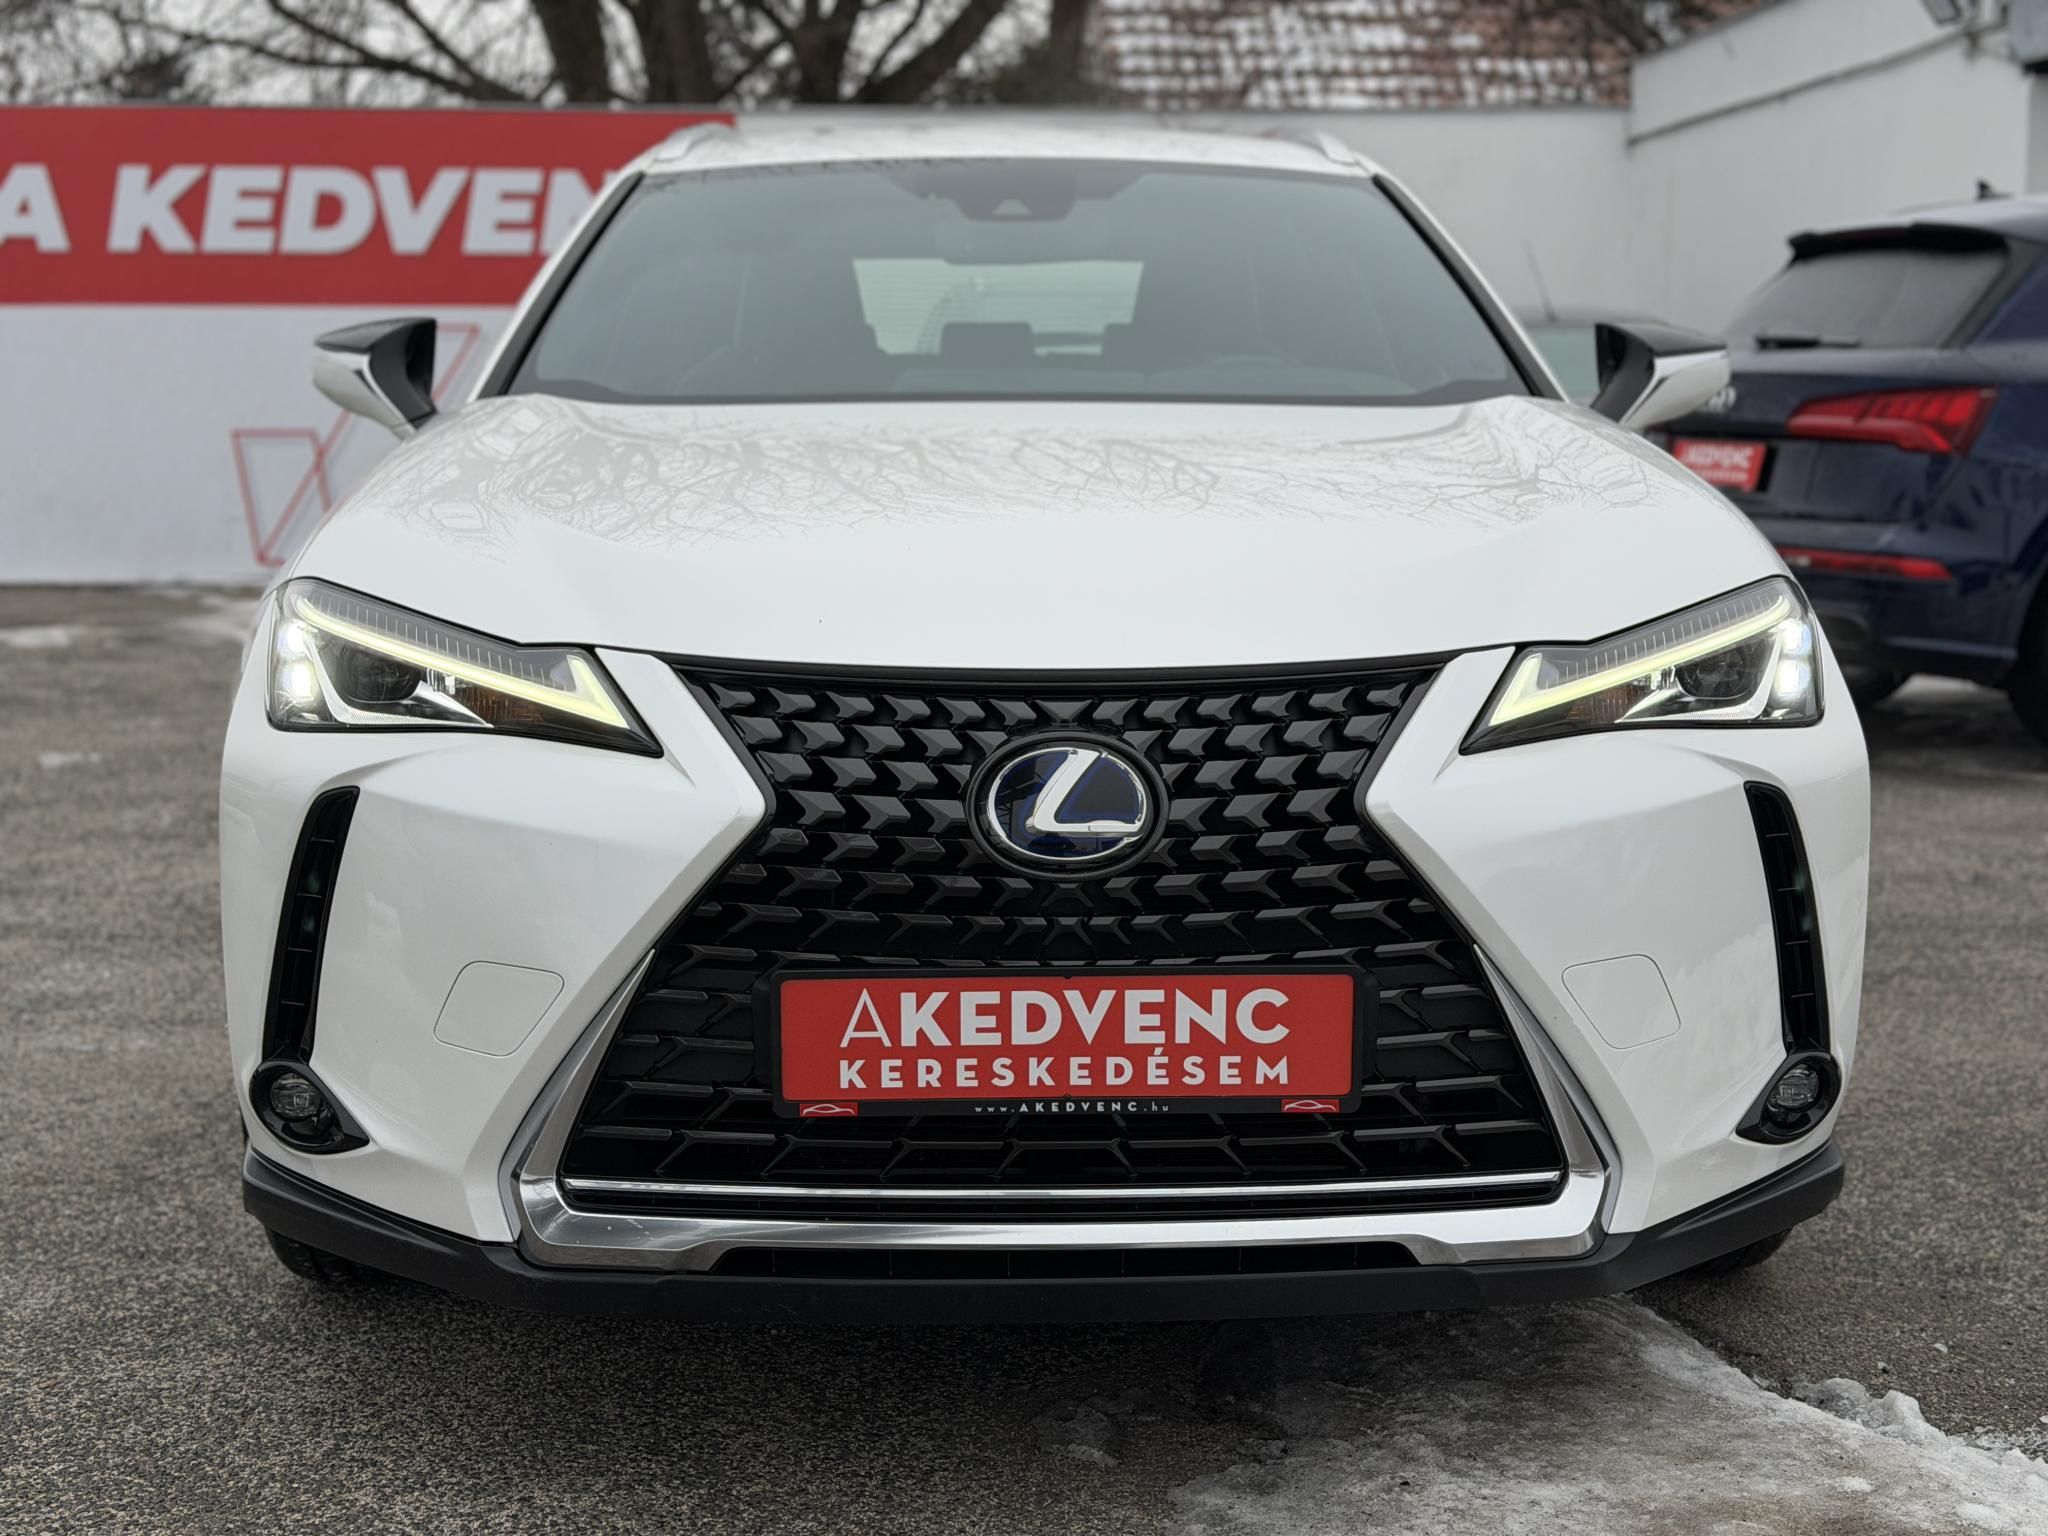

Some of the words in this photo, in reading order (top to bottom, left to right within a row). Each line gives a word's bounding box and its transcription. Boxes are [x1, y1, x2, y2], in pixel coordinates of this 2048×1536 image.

[0, 164, 70, 253] A
[839, 1047, 1289, 1089] KERESKEDÉSEM
[974, 1101, 1170, 1113] www.AKEDVENC.hu
